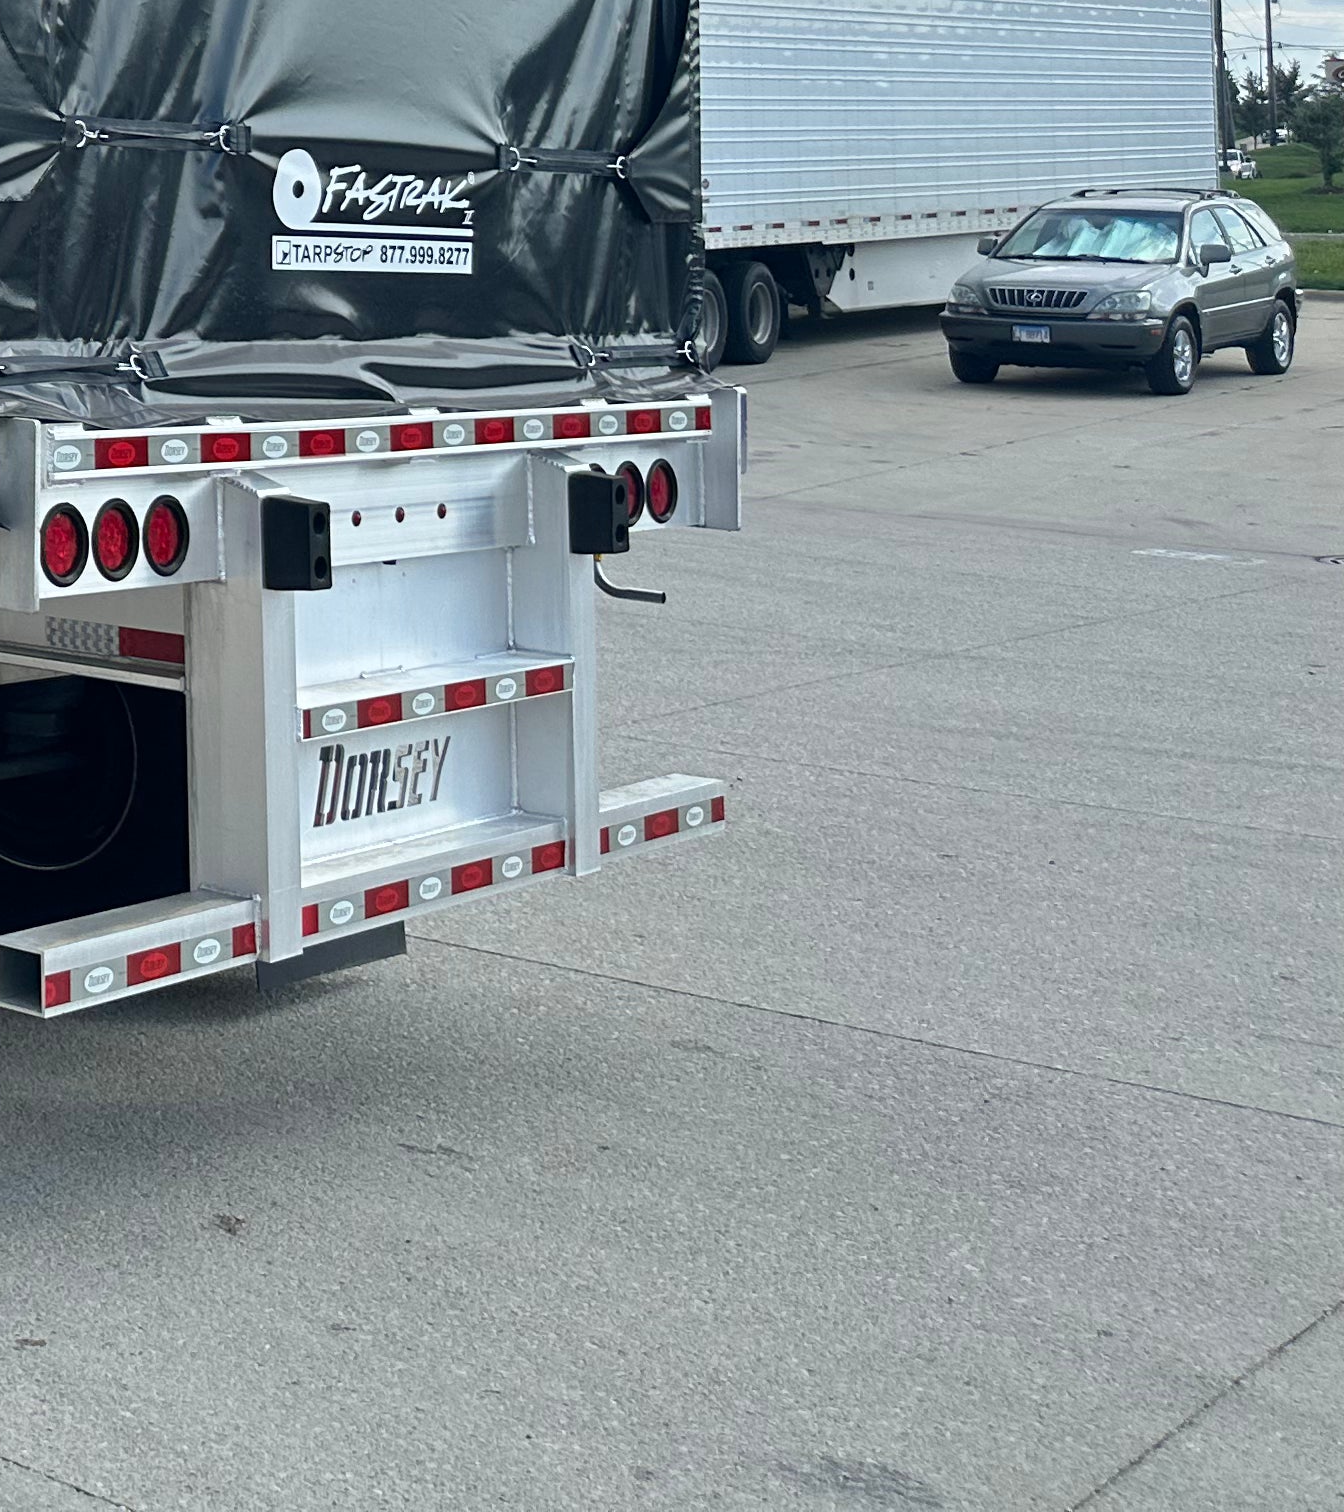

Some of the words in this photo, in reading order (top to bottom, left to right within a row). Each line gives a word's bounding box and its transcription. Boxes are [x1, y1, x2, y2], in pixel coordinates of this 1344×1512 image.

[322, 165, 469, 220] FASTRAK
[292, 243, 373, 263] TARPSTOP
[380, 245, 469, 266] 877.999.8277
[313, 736, 451, 828] DORSEY
